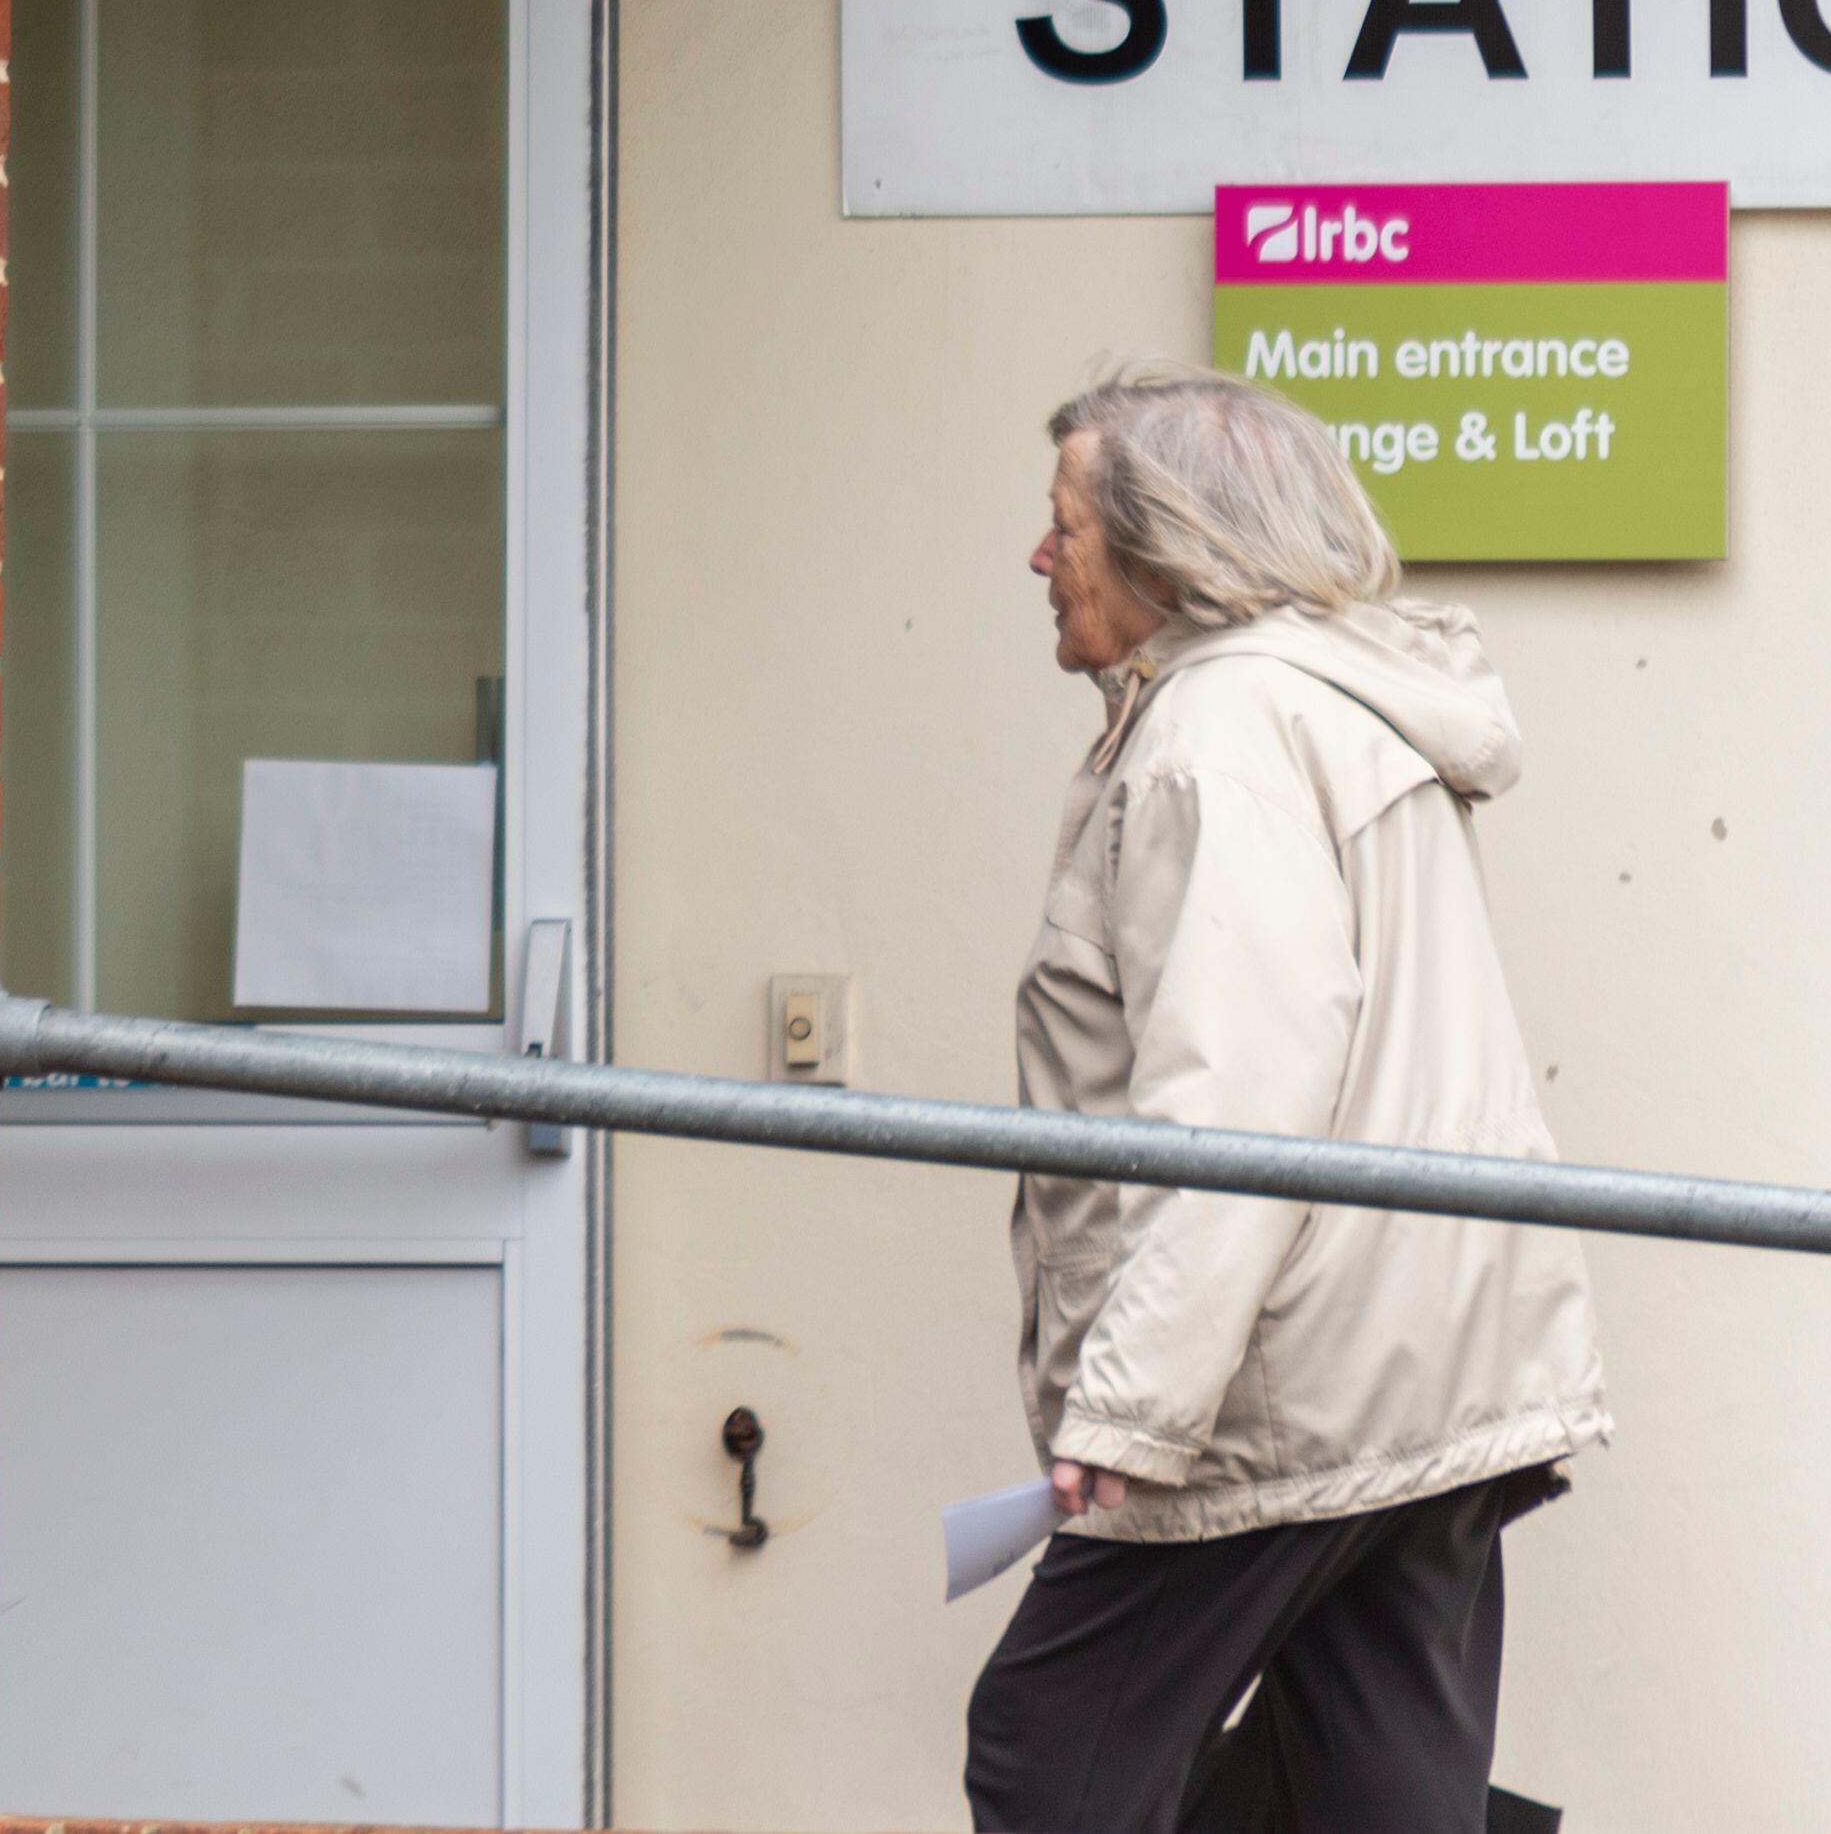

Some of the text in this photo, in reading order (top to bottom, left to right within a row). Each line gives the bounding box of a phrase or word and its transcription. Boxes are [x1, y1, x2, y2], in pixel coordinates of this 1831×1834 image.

[1244, 326, 1631, 379] Main entrance
[1452, 409, 1498, 462] &
[1512, 405, 1617, 462] Loft
